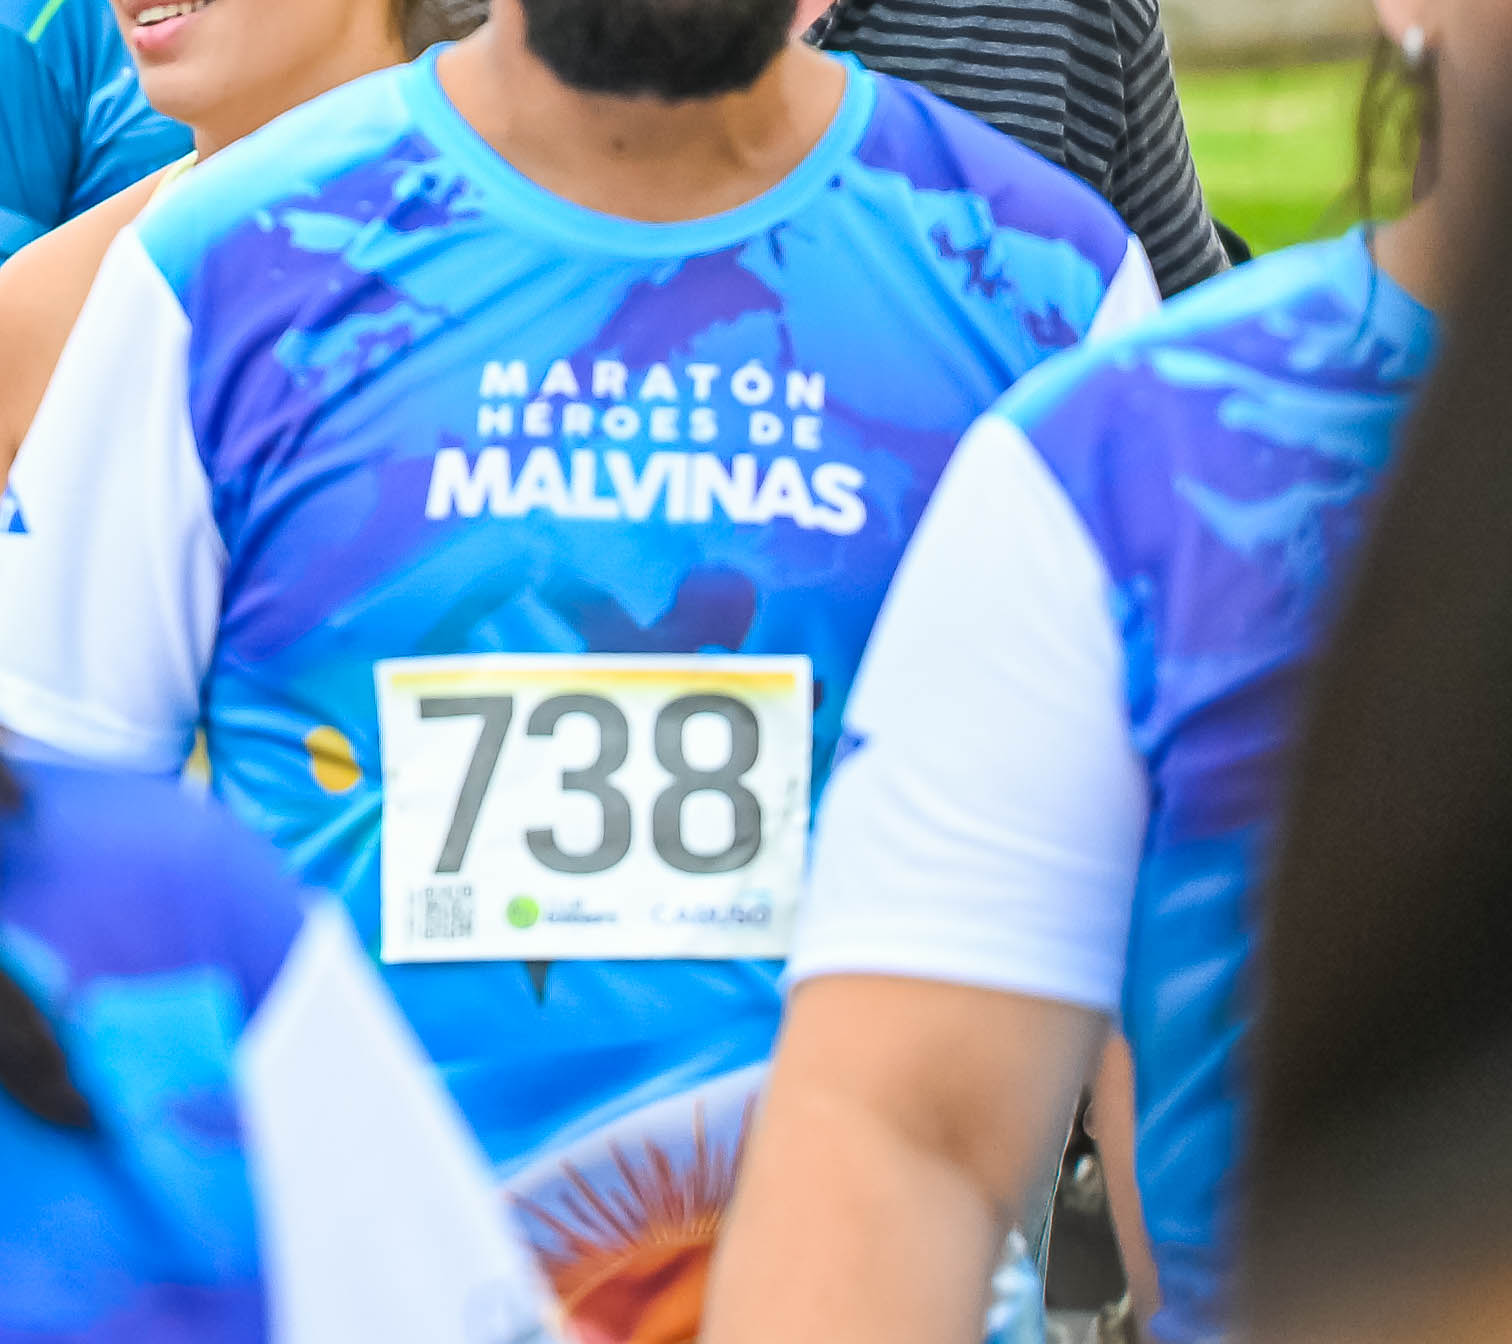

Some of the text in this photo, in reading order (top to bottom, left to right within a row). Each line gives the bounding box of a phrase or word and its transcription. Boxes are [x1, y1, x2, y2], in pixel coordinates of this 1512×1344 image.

[478, 357, 826, 411] MARATÓN
[476, 396, 824, 452] HÉROES DE
[424, 445, 868, 537] MALVINAS
[420, 693, 762, 874] 738
